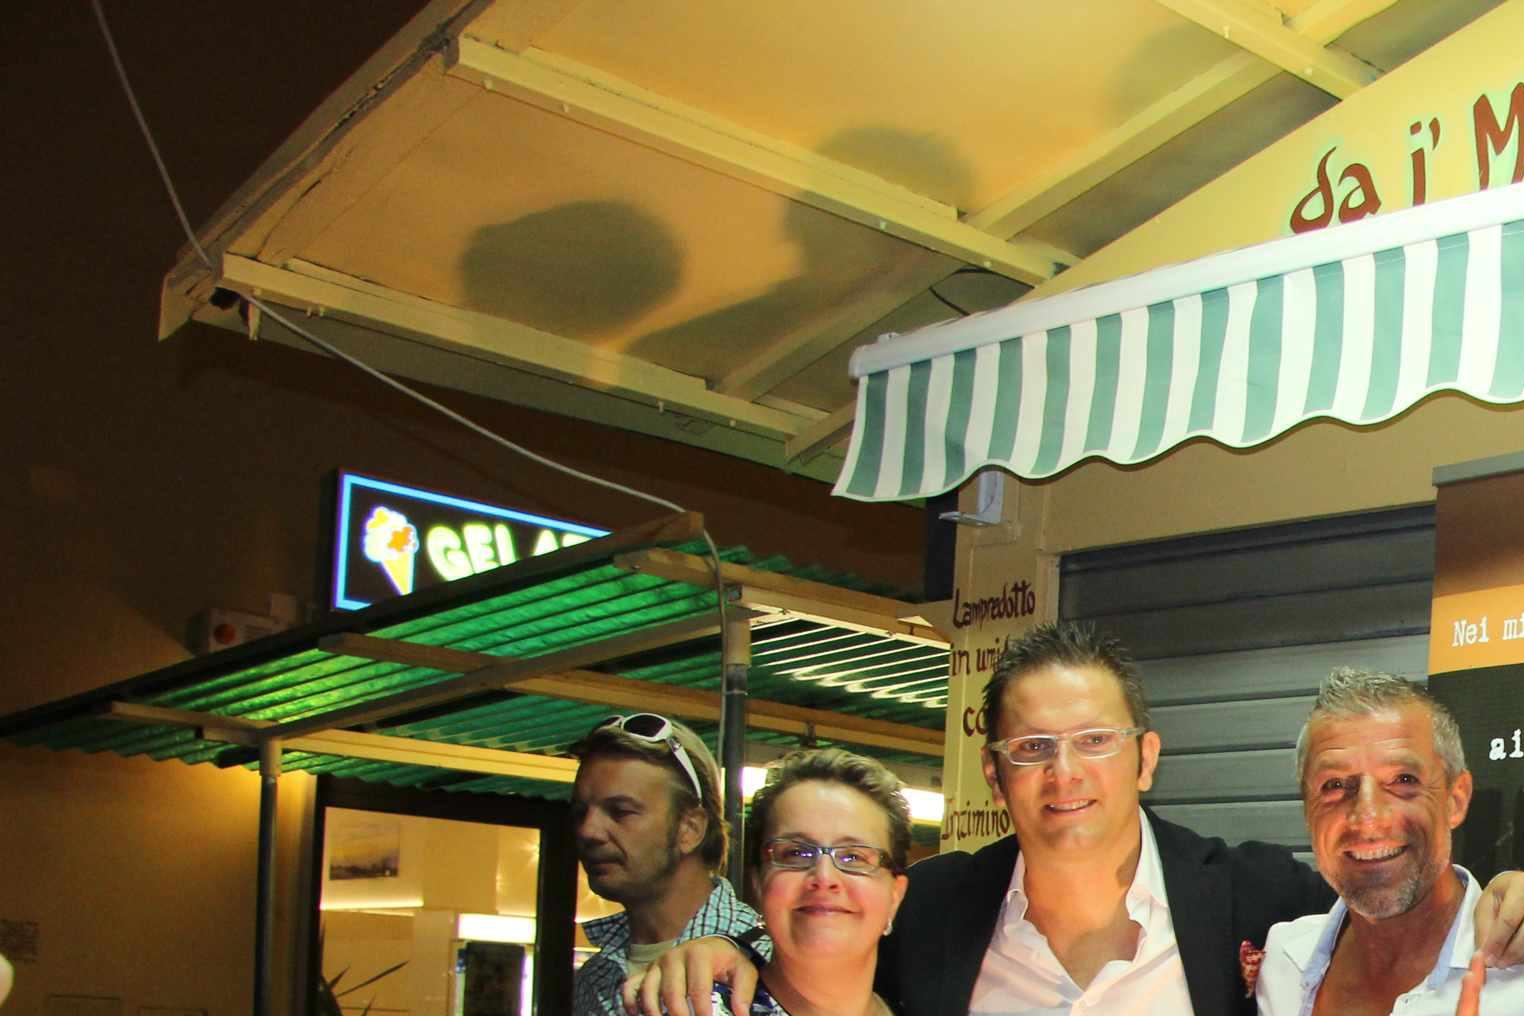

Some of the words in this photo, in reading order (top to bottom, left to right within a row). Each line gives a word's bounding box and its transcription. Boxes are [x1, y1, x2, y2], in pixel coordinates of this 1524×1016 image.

[1290, 147, 1382, 235] da
[952, 580, 1036, 630] Lampredotto
[1452, 616, 1490, 648] Nei
[949, 642, 971, 678] in
[1488, 728, 1524, 762] ai
